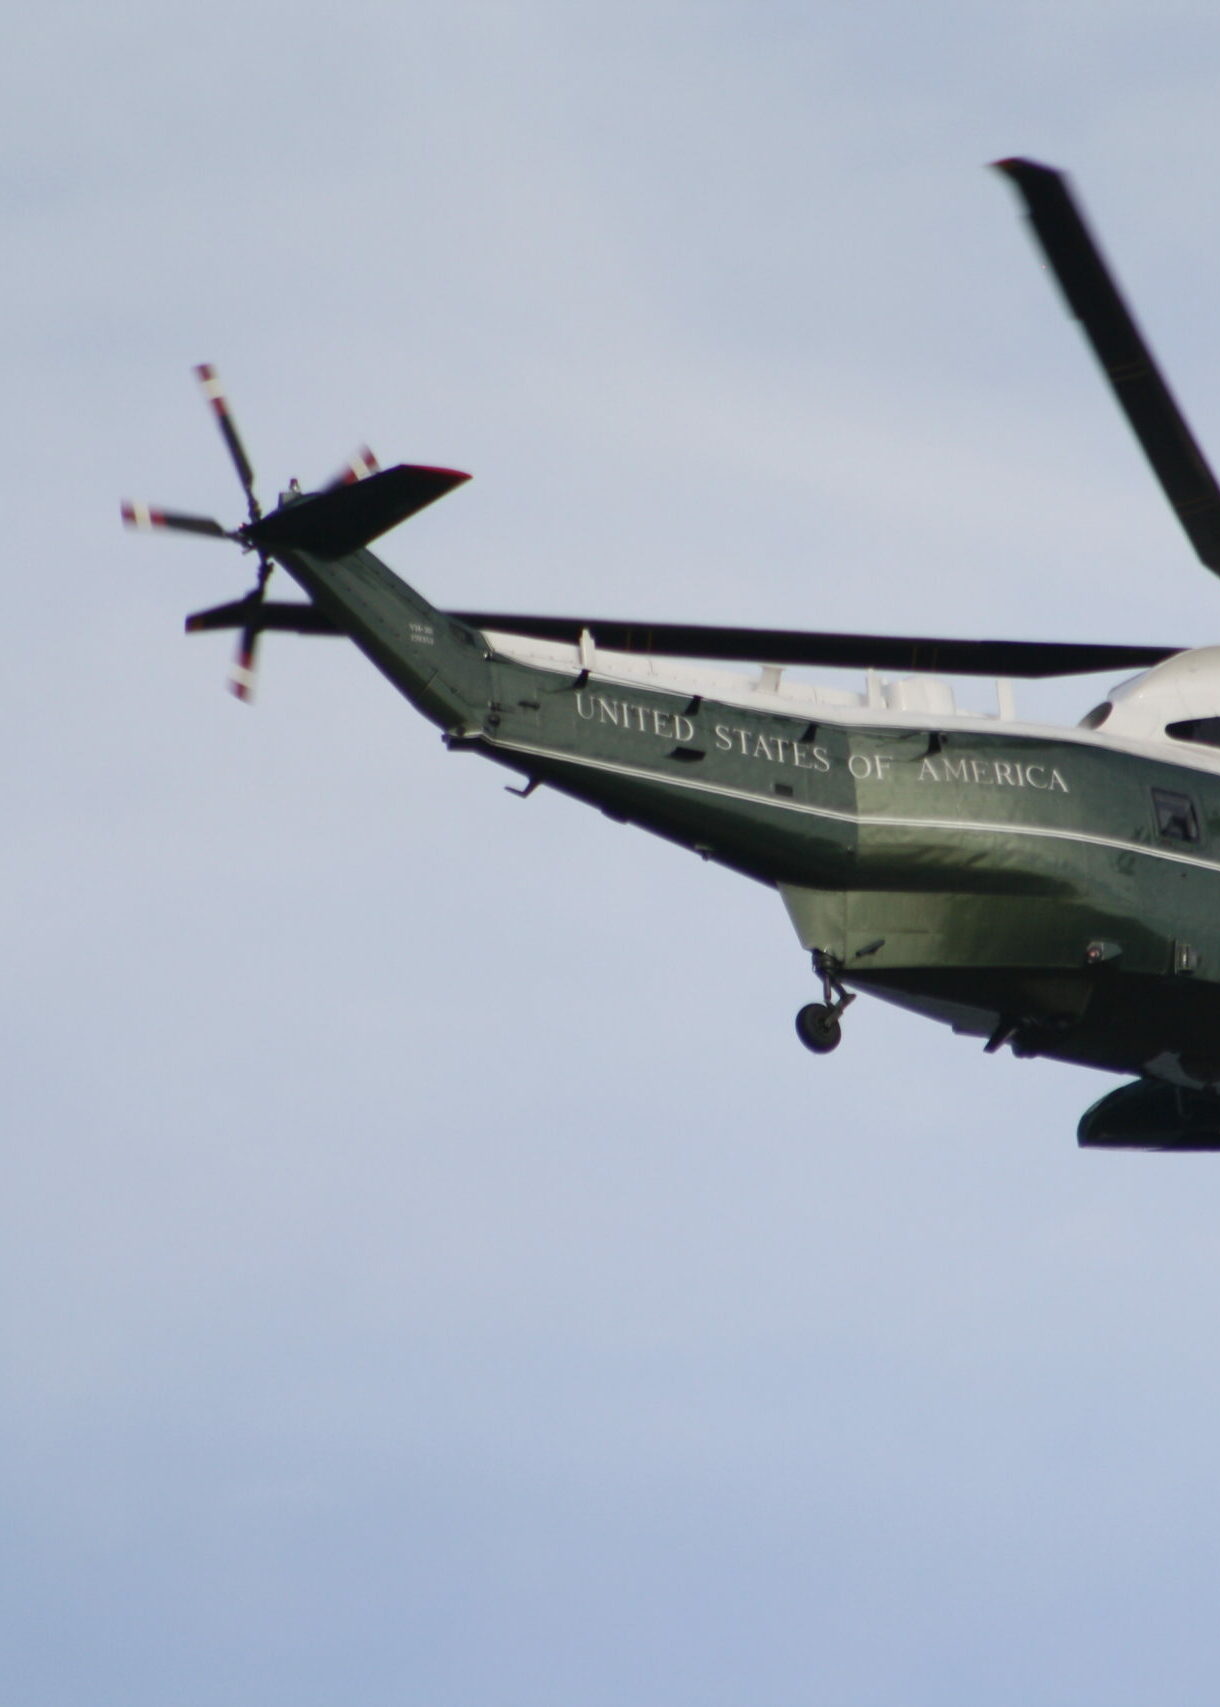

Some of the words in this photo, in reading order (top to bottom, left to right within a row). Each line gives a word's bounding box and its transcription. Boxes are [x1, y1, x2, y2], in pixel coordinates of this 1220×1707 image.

[576, 693, 694, 742] UNITED
[716, 725, 830, 773] STATES
[848, 755, 893, 780] OF
[918, 758, 1069, 793] AMERICA
